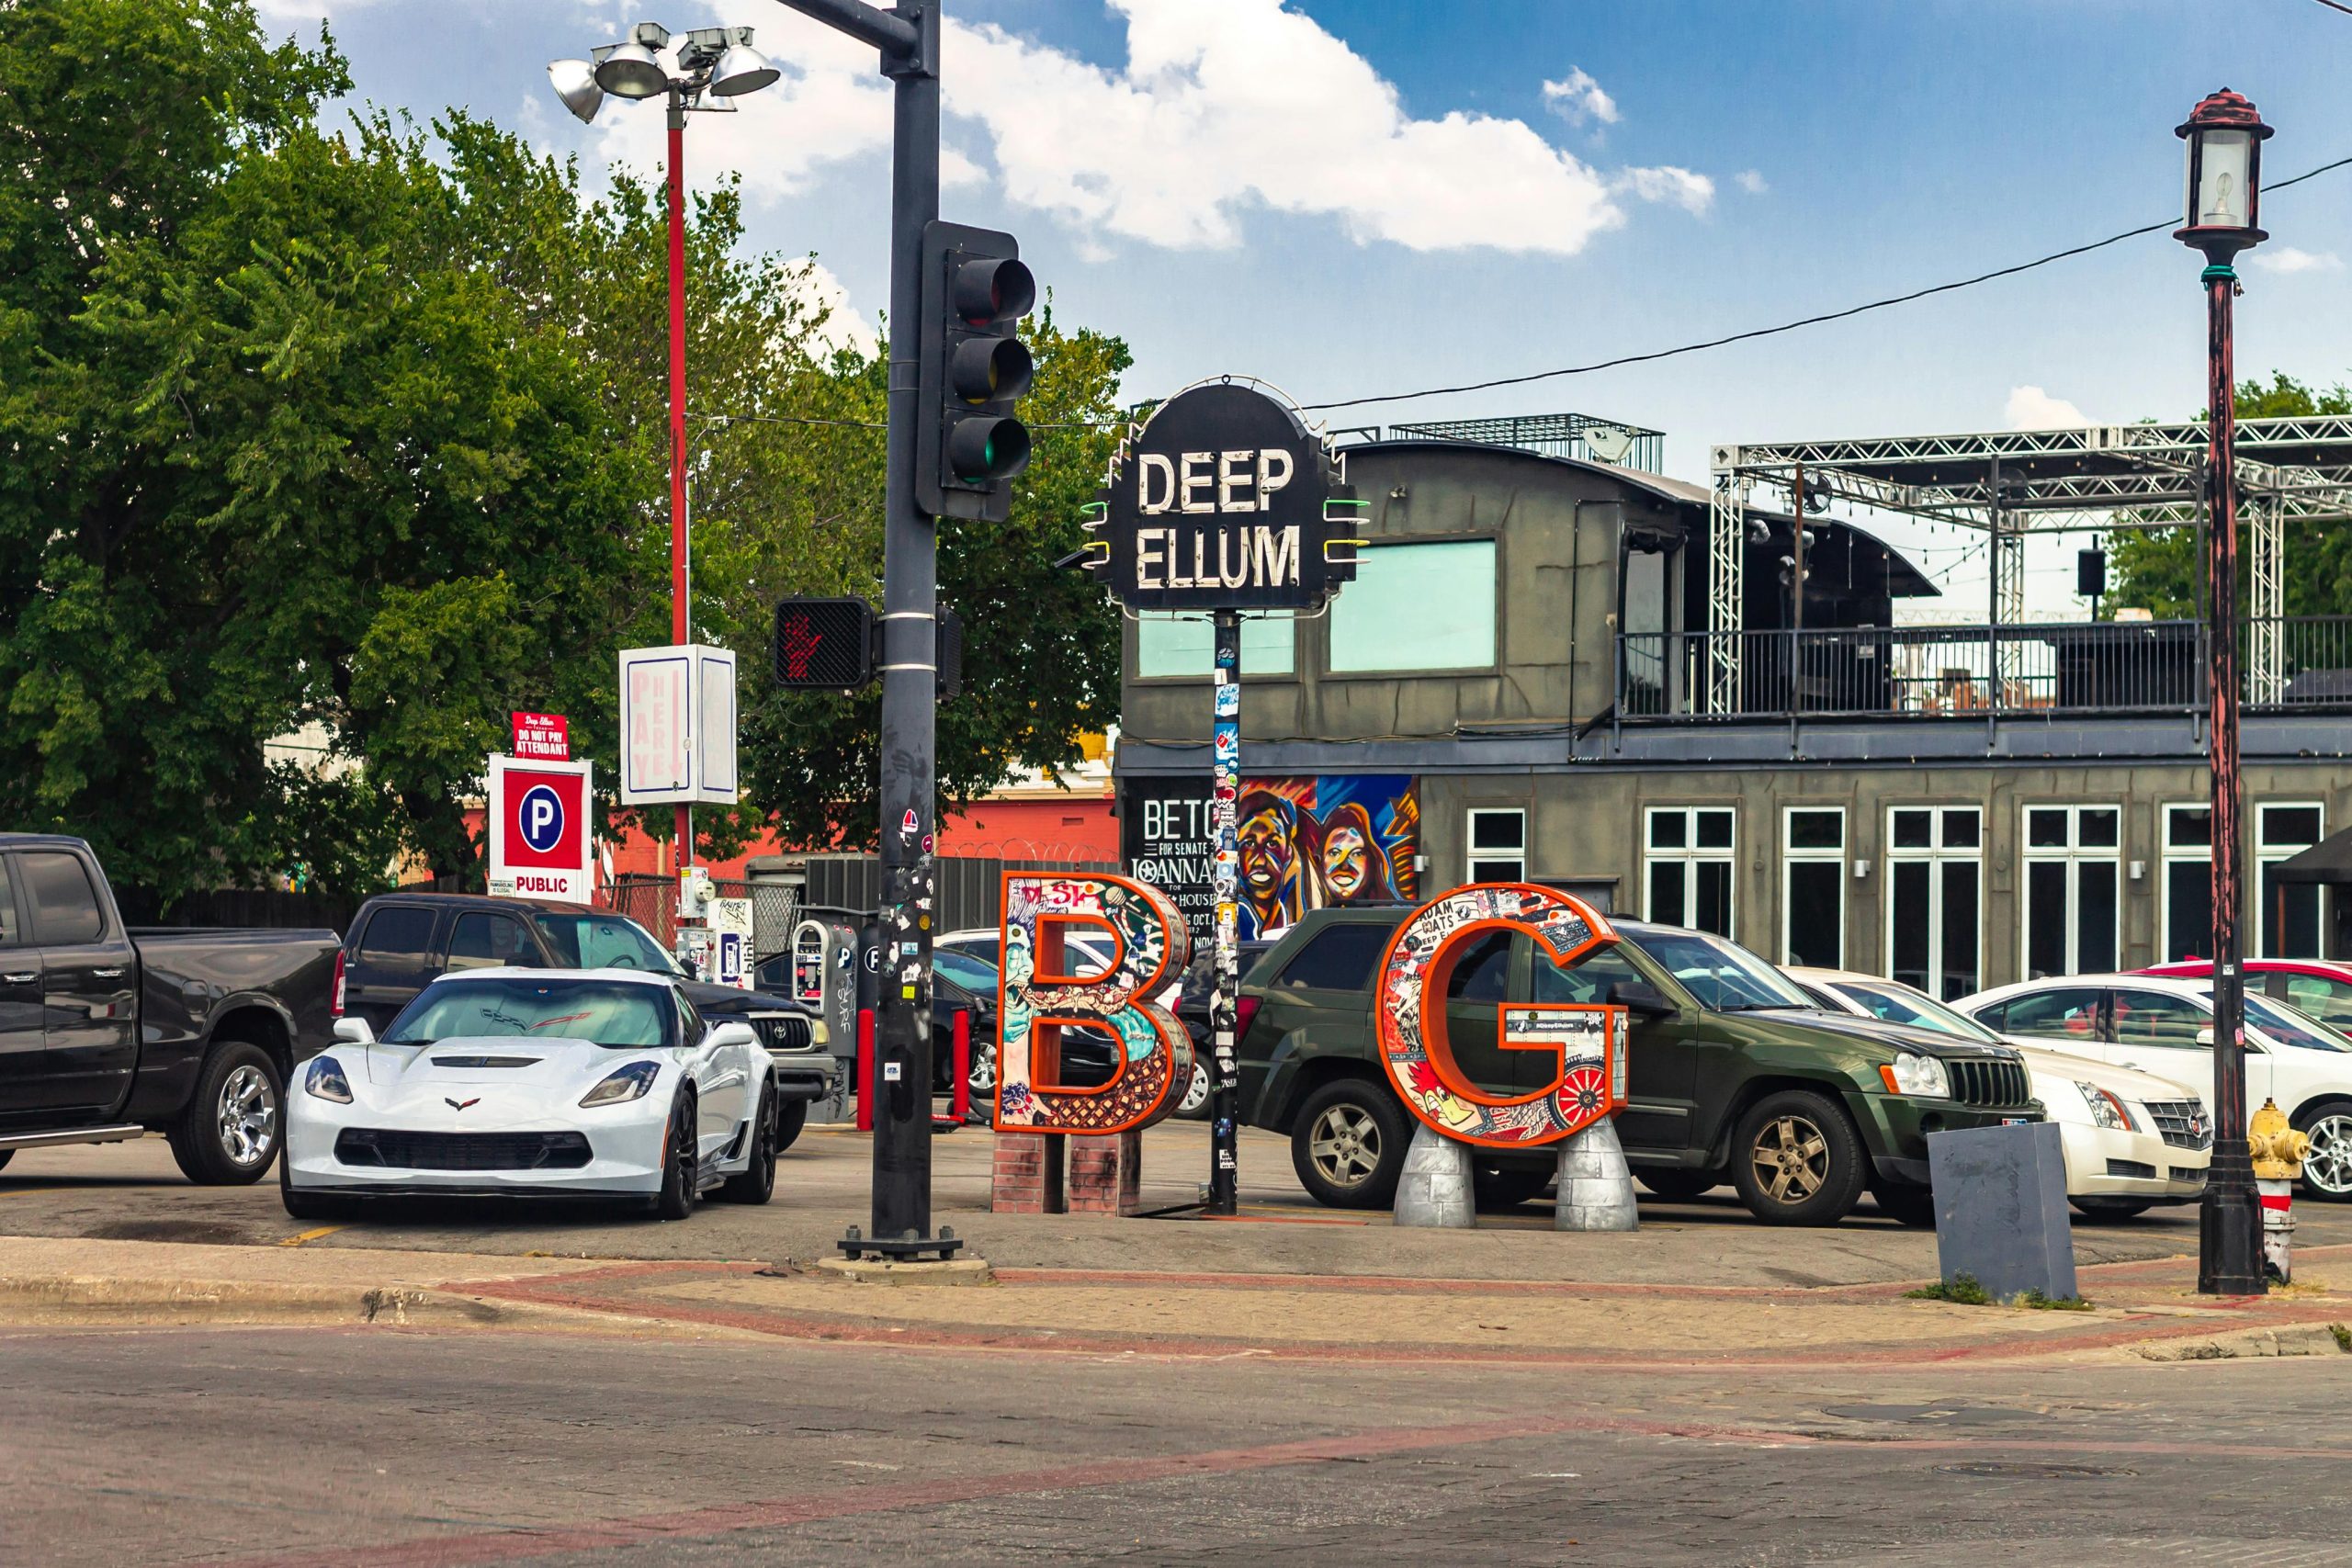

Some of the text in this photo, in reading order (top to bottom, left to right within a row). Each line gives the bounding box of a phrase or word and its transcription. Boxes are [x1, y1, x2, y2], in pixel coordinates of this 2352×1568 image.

[1139, 448, 1294, 514] DEEP
[1136, 525, 1300, 589] ELLUM
[516, 740, 568, 755] ATTENDANT
[518, 729, 563, 743] DO NOT PAY
[532, 798, 554, 840] P
[1159, 842, 1208, 856] FOR SENATE
[1131, 858, 1214, 884] JOANNA
[516, 876, 568, 893] PUBLIC
[1419, 935, 1438, 946] EEP
[743, 934, 753, 974] blink
[1375, 882, 1629, 1147] G
